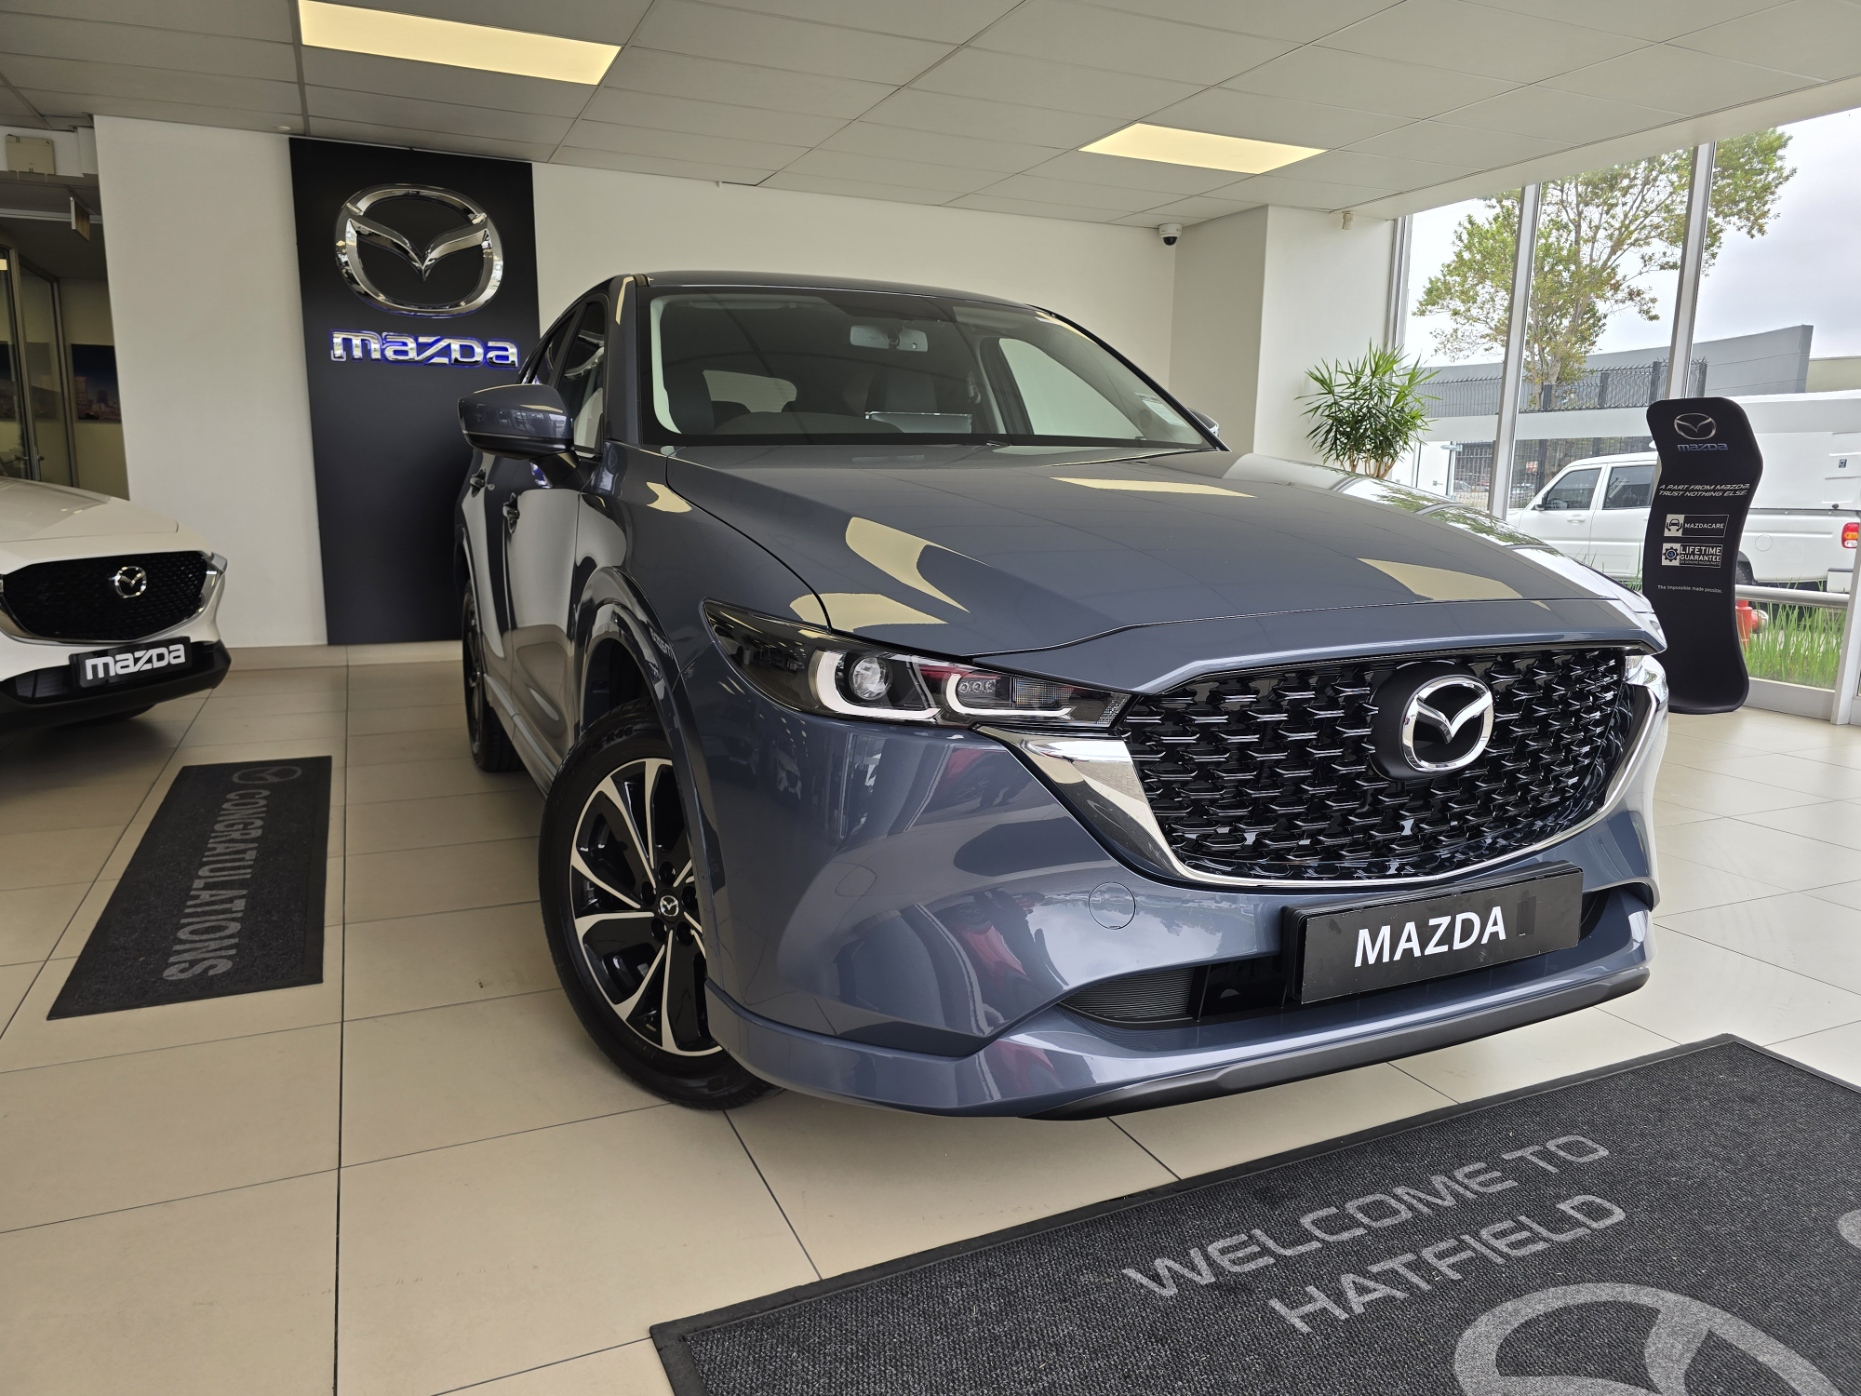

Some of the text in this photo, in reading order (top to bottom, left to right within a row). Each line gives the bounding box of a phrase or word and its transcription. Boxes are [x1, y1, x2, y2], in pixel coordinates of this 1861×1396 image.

[331, 330, 519, 368] mazda
[1680, 546, 1721, 555] LIFETIME
[85, 643, 186, 680] mazda
[163, 789, 271, 981] CONGRATULATIONS
[1354, 905, 1507, 968] MAZDA
[1122, 1134, 1610, 1297] WELCOME TO
[1269, 1194, 1626, 1334] HATFIELD
